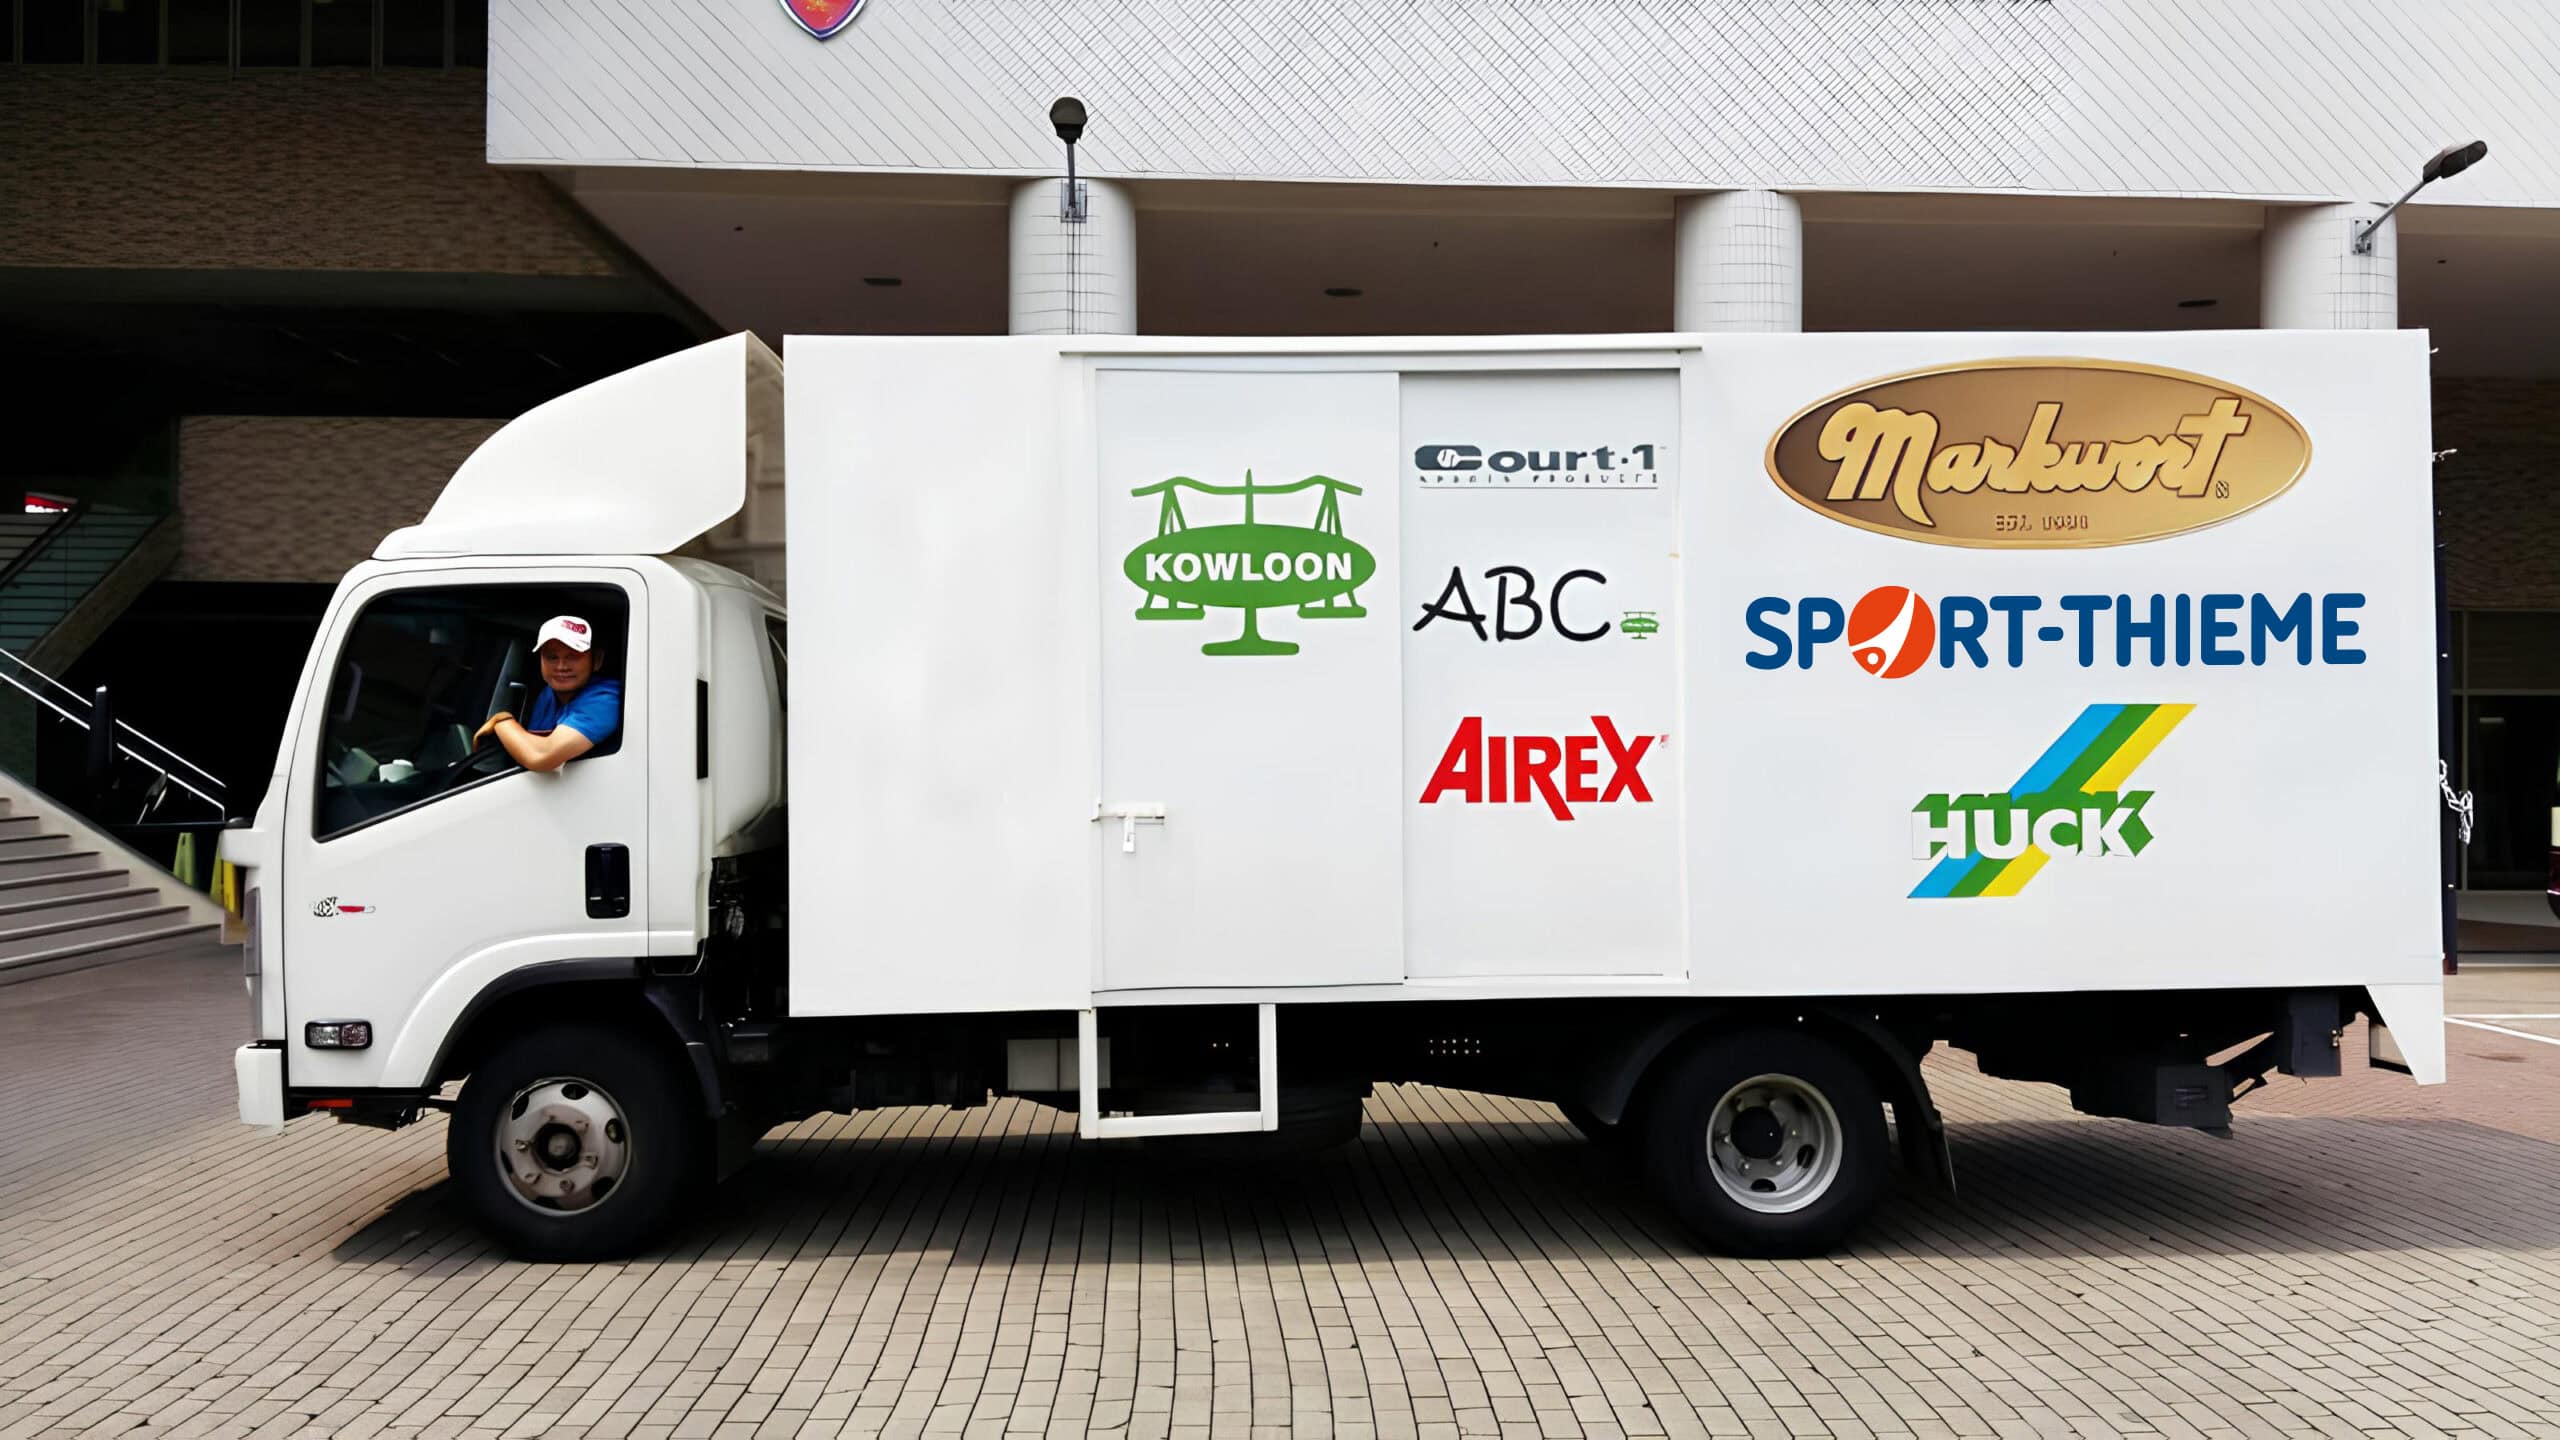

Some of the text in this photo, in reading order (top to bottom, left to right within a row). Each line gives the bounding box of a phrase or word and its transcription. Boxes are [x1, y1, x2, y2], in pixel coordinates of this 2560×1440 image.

[1818, 398, 2251, 527] Markwort
[1146, 552, 1352, 582] KOWLOON
[1413, 566, 1611, 642] ABC
[1745, 586, 2367, 679] SPORT-THIEME
[1419, 715, 1655, 821] AIREX
[1911, 800, 2140, 860] HUCK
